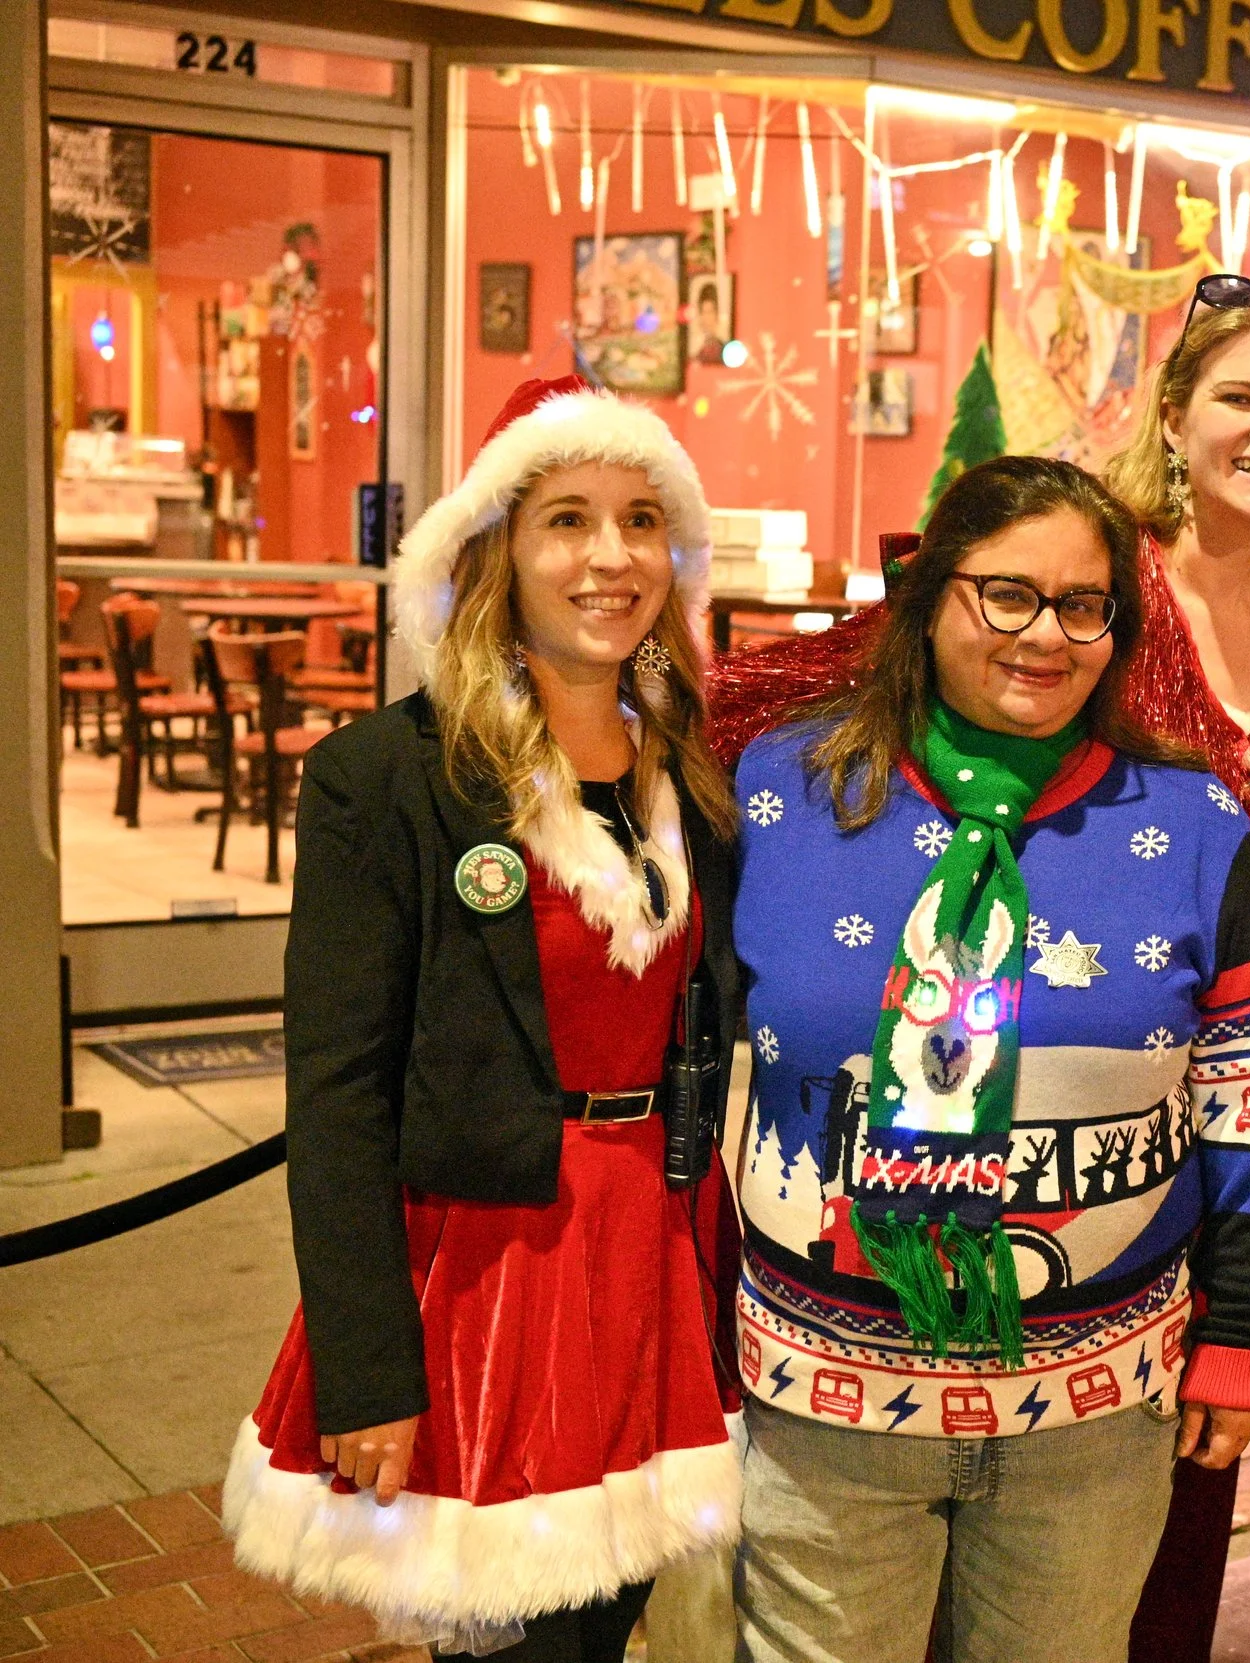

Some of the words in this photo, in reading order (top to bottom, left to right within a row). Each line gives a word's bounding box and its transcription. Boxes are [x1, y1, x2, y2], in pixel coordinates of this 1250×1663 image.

[176, 31, 257, 77] 224
[463, 853, 482, 876] HEY
[482, 850, 517, 871] SANTA
[463, 884, 484, 906] YOU
[486, 881, 520, 907] GAME?
[913, 1144, 930, 1155] ON/OFF
